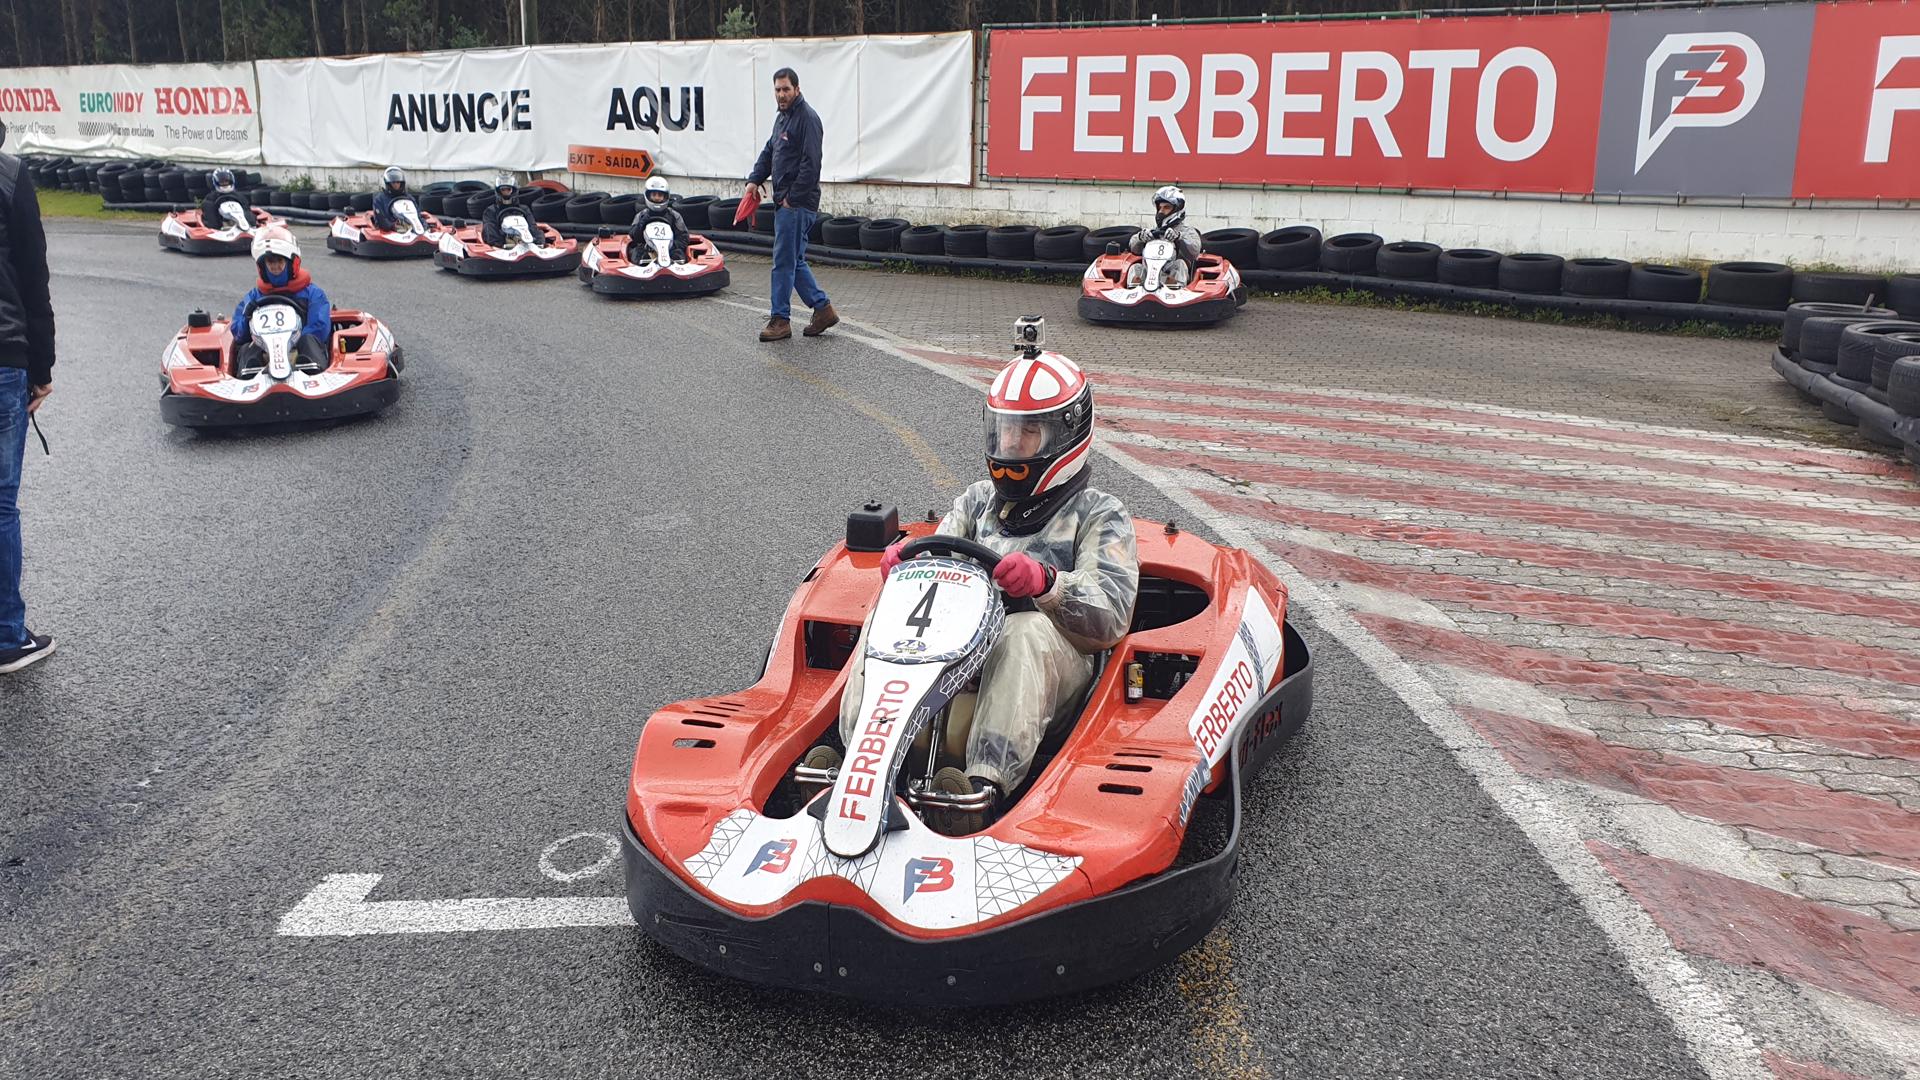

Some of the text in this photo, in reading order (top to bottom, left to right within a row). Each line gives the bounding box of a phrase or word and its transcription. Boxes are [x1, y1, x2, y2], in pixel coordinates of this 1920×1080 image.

[0, 87, 61, 112] ONDA
[79, 92, 144, 113] EUROINDY
[154, 87, 251, 114] HONDA
[387, 86, 704, 135] ANUNCIE AQUI
[1019, 46, 1557, 162] FERBERTO
[164, 125, 180, 139] The
[182, 126, 205, 140] Power
[215, 126, 249, 141] Dreams
[569, 152, 595, 165] EXIT
[605, 154, 640, 169] SAÍDA
[653, 226, 666, 237] 24
[1158, 244, 1165, 256] 8
[260, 311, 285, 329] 28
[896, 570, 972, 583] EUROINDY
[905, 582, 939, 638] 4
[1194, 660, 1254, 759] ERBERTO
[839, 679, 910, 822] FERBERTO
